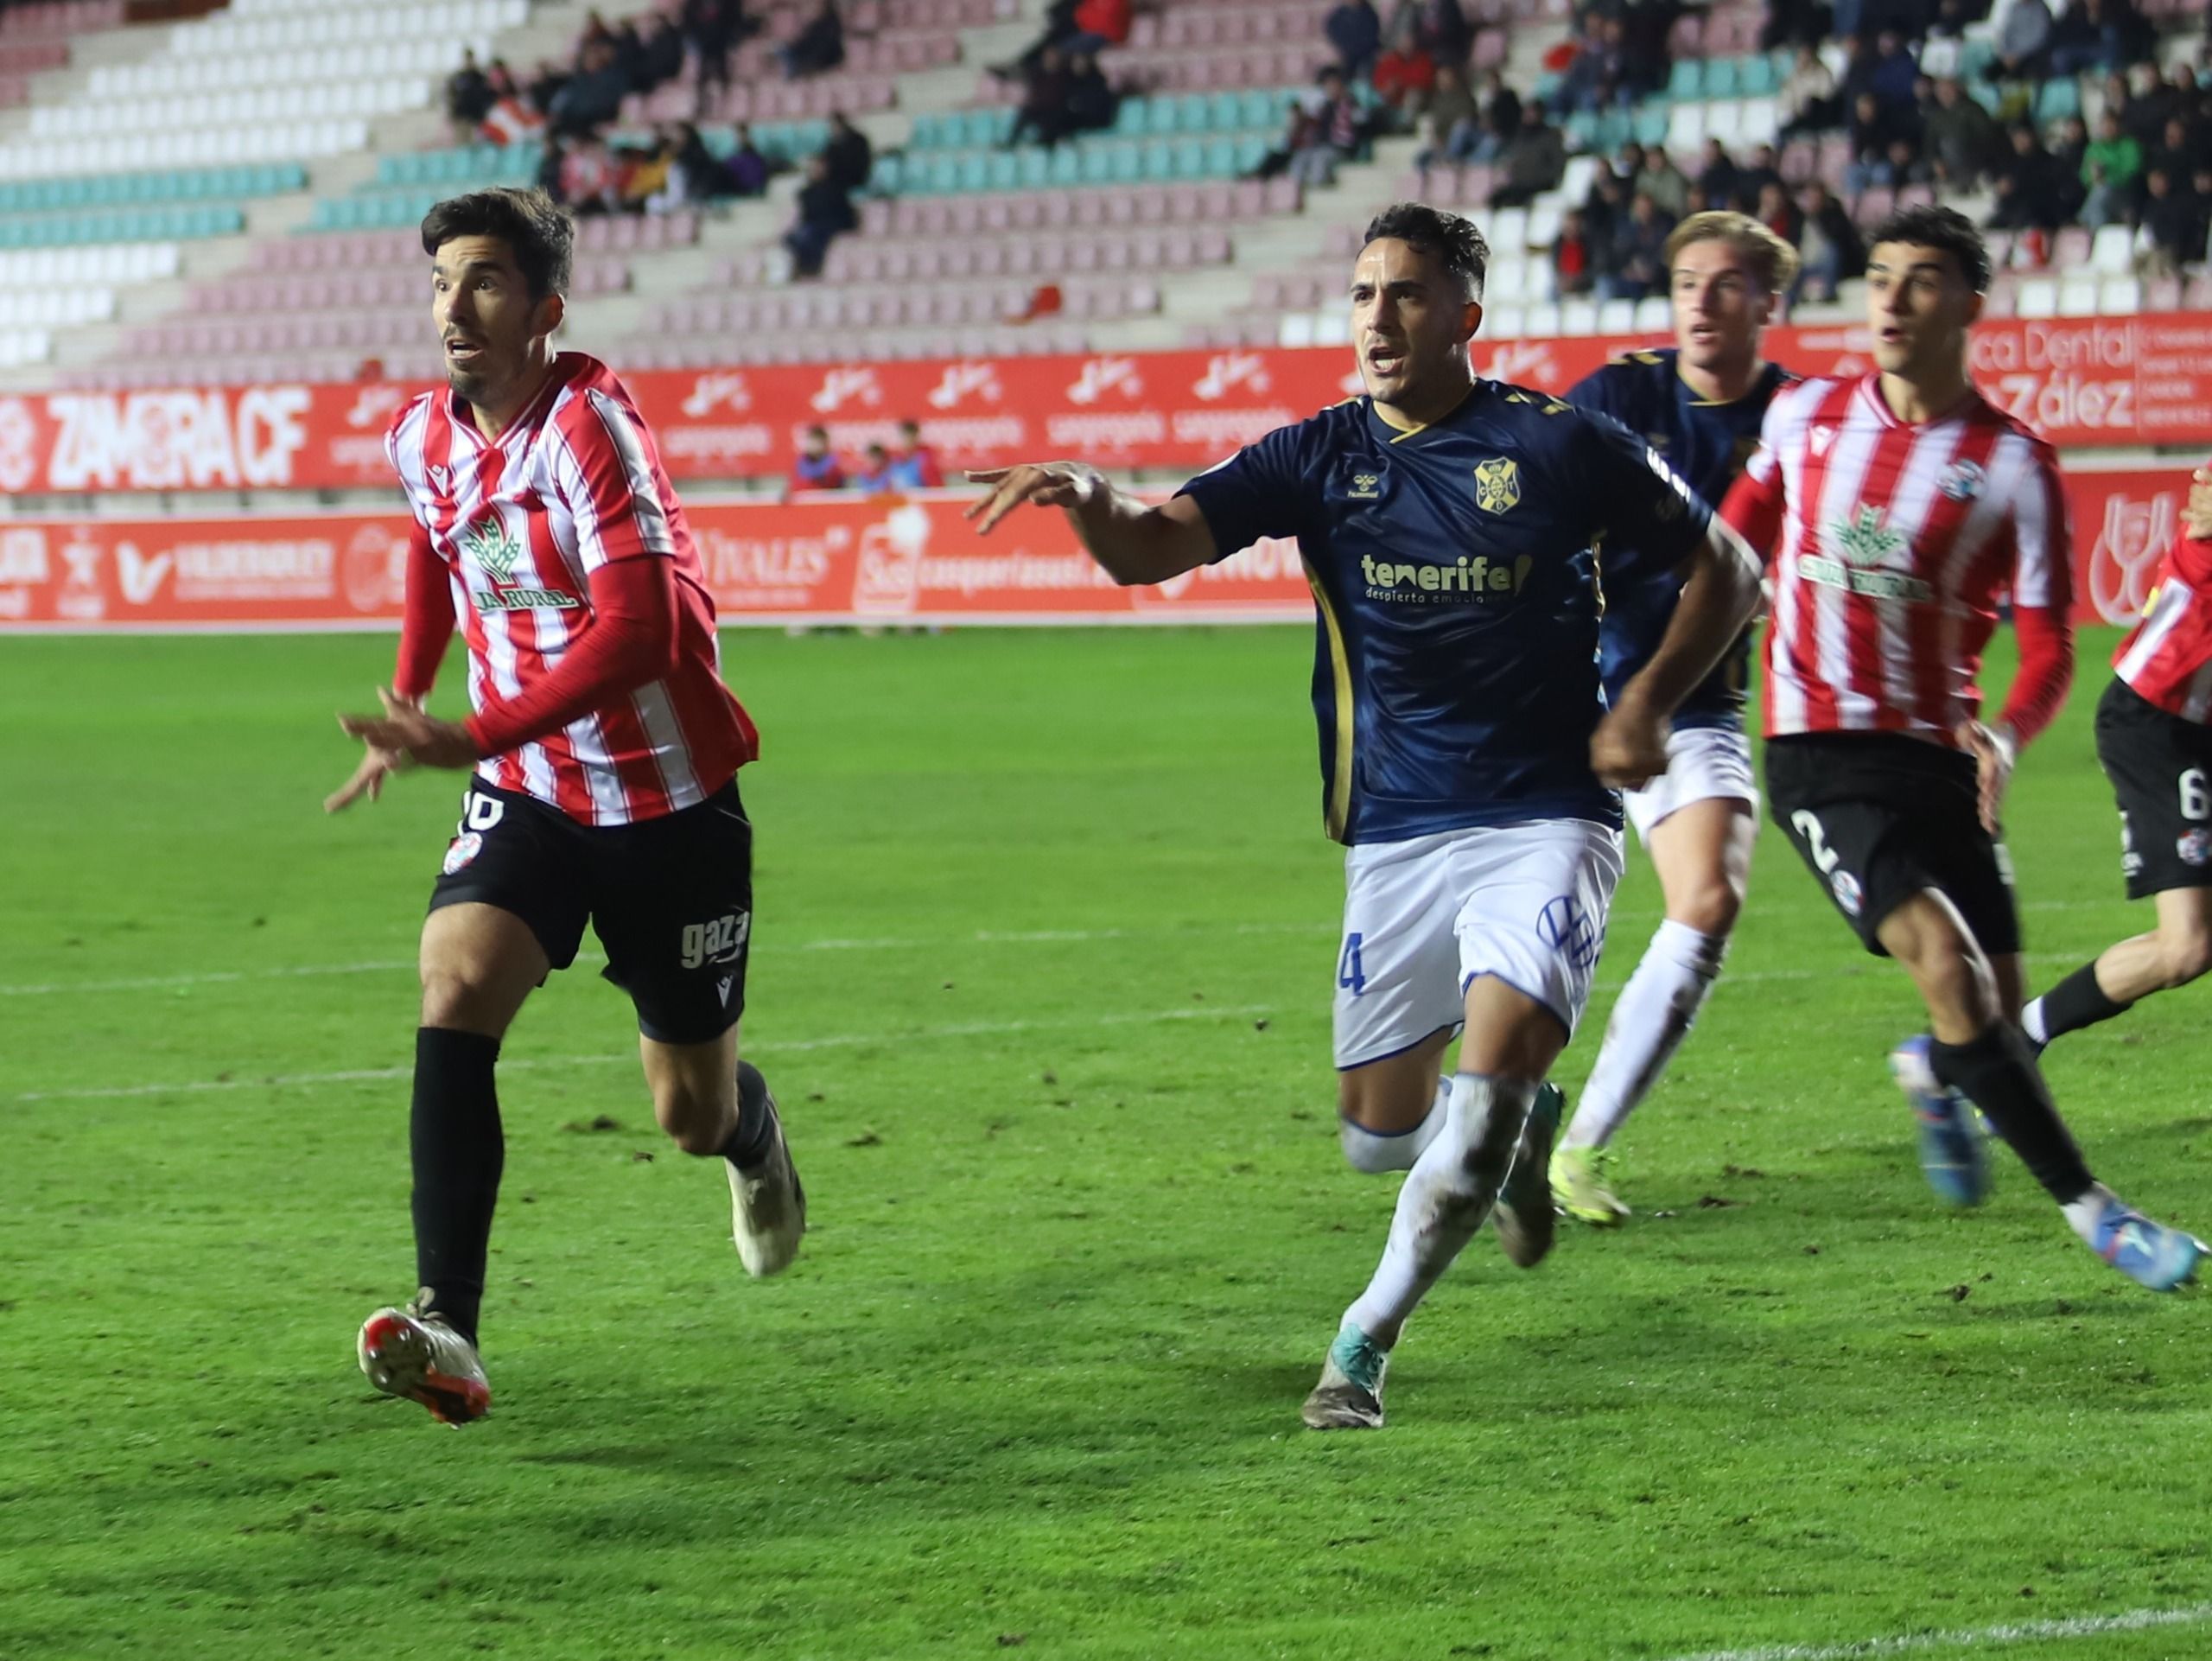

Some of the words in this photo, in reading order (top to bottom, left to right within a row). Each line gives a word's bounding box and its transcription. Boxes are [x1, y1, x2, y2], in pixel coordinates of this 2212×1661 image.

[2024, 318, 2133, 369] Dental
[236, 386, 313, 485] CF
[504, 589, 575, 608] RURAL
[1365, 587, 1426, 603] despierta
[2178, 767, 2210, 820] 6
[1791, 809, 1840, 875] 2
[1340, 932, 1365, 996] 4
